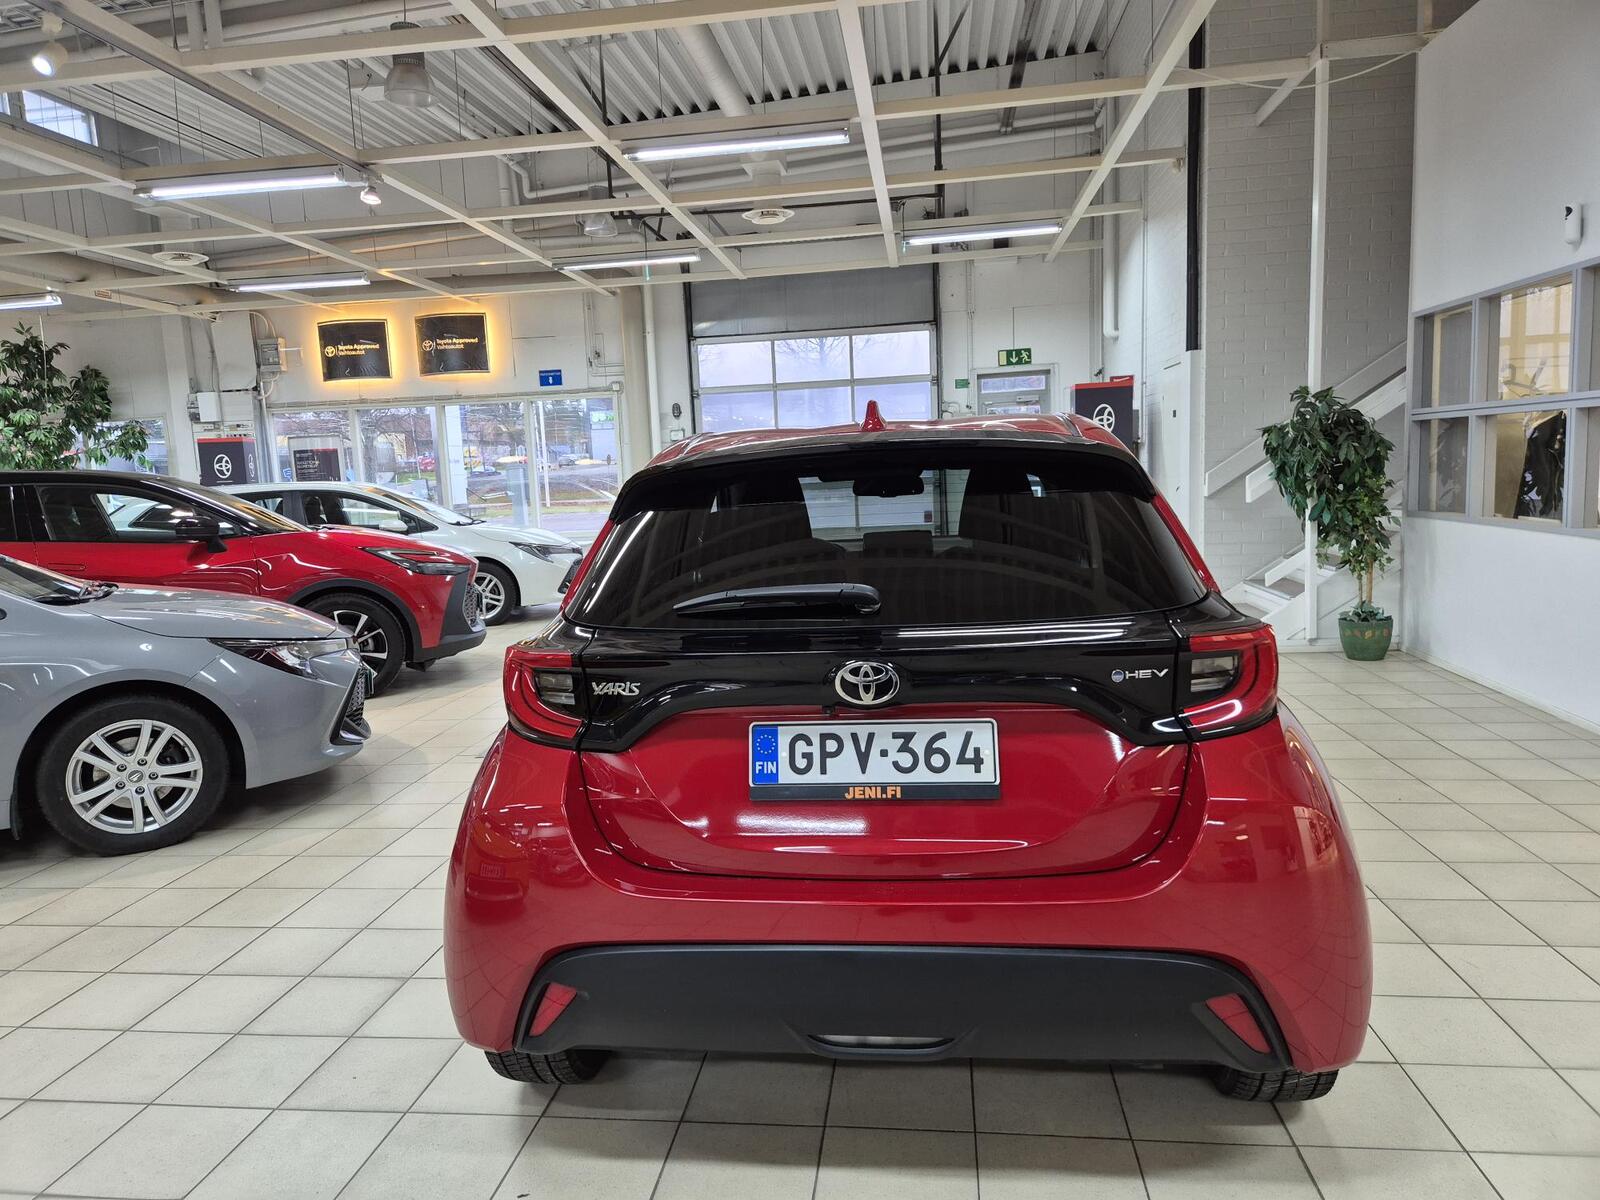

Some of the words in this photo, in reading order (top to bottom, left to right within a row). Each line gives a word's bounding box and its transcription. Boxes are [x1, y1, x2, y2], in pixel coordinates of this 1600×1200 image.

[1125, 668, 1169, 680] HEV
[591, 681, 641, 696] YARIS
[755, 761, 777, 774] FIN
[844, 785, 902, 799] JENI.FI
